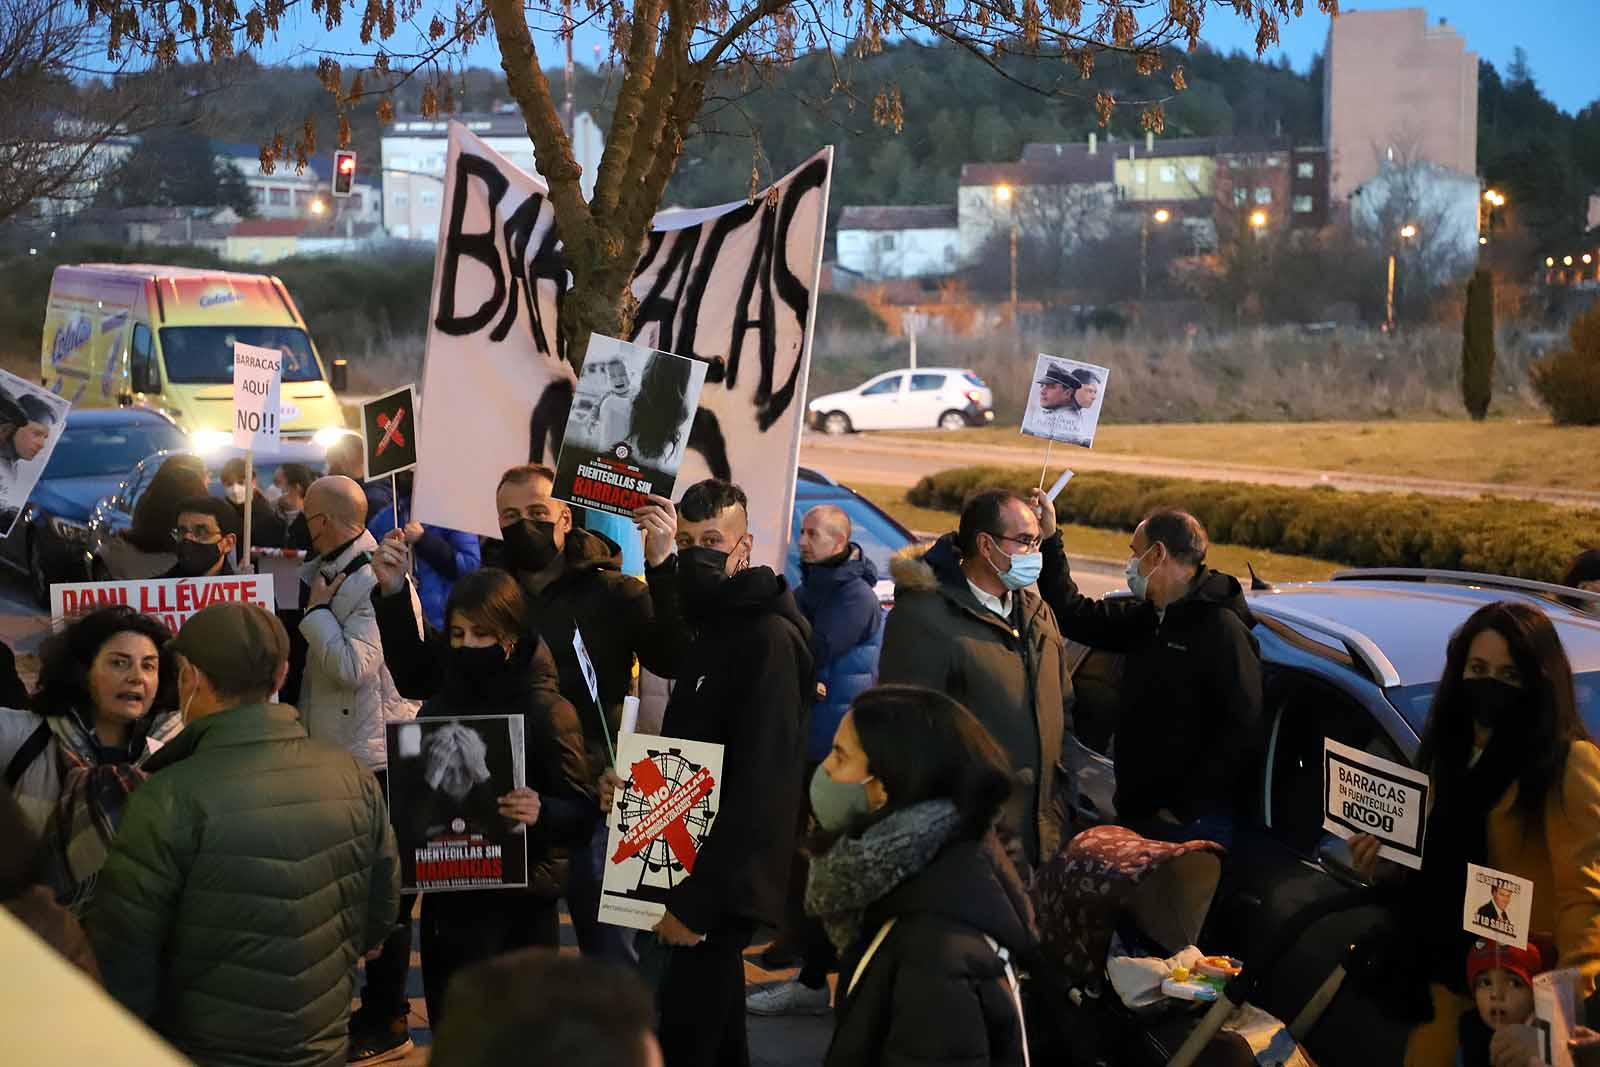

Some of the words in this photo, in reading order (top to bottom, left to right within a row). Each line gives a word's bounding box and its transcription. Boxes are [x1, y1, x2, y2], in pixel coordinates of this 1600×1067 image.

[236, 354, 280, 371] BARRACAS
[242, 379, 269, 396] AQUÍ
[237, 409, 275, 435] NO!!
[577, 464, 636, 490] FUENTECILLAS
[636, 480, 653, 494] SIN
[647, 785, 671, 810] NO
[1338, 766, 1406, 804] BARRACAS
[623, 828, 638, 844] EN
[637, 772, 706, 833] FUENTECILLAS
[1339, 783, 1347, 797] EN
[1348, 788, 1404, 818] FUENTECILLAS
[415, 846, 482, 862] FUENTECILLAS
[485, 845, 501, 858] SIN
